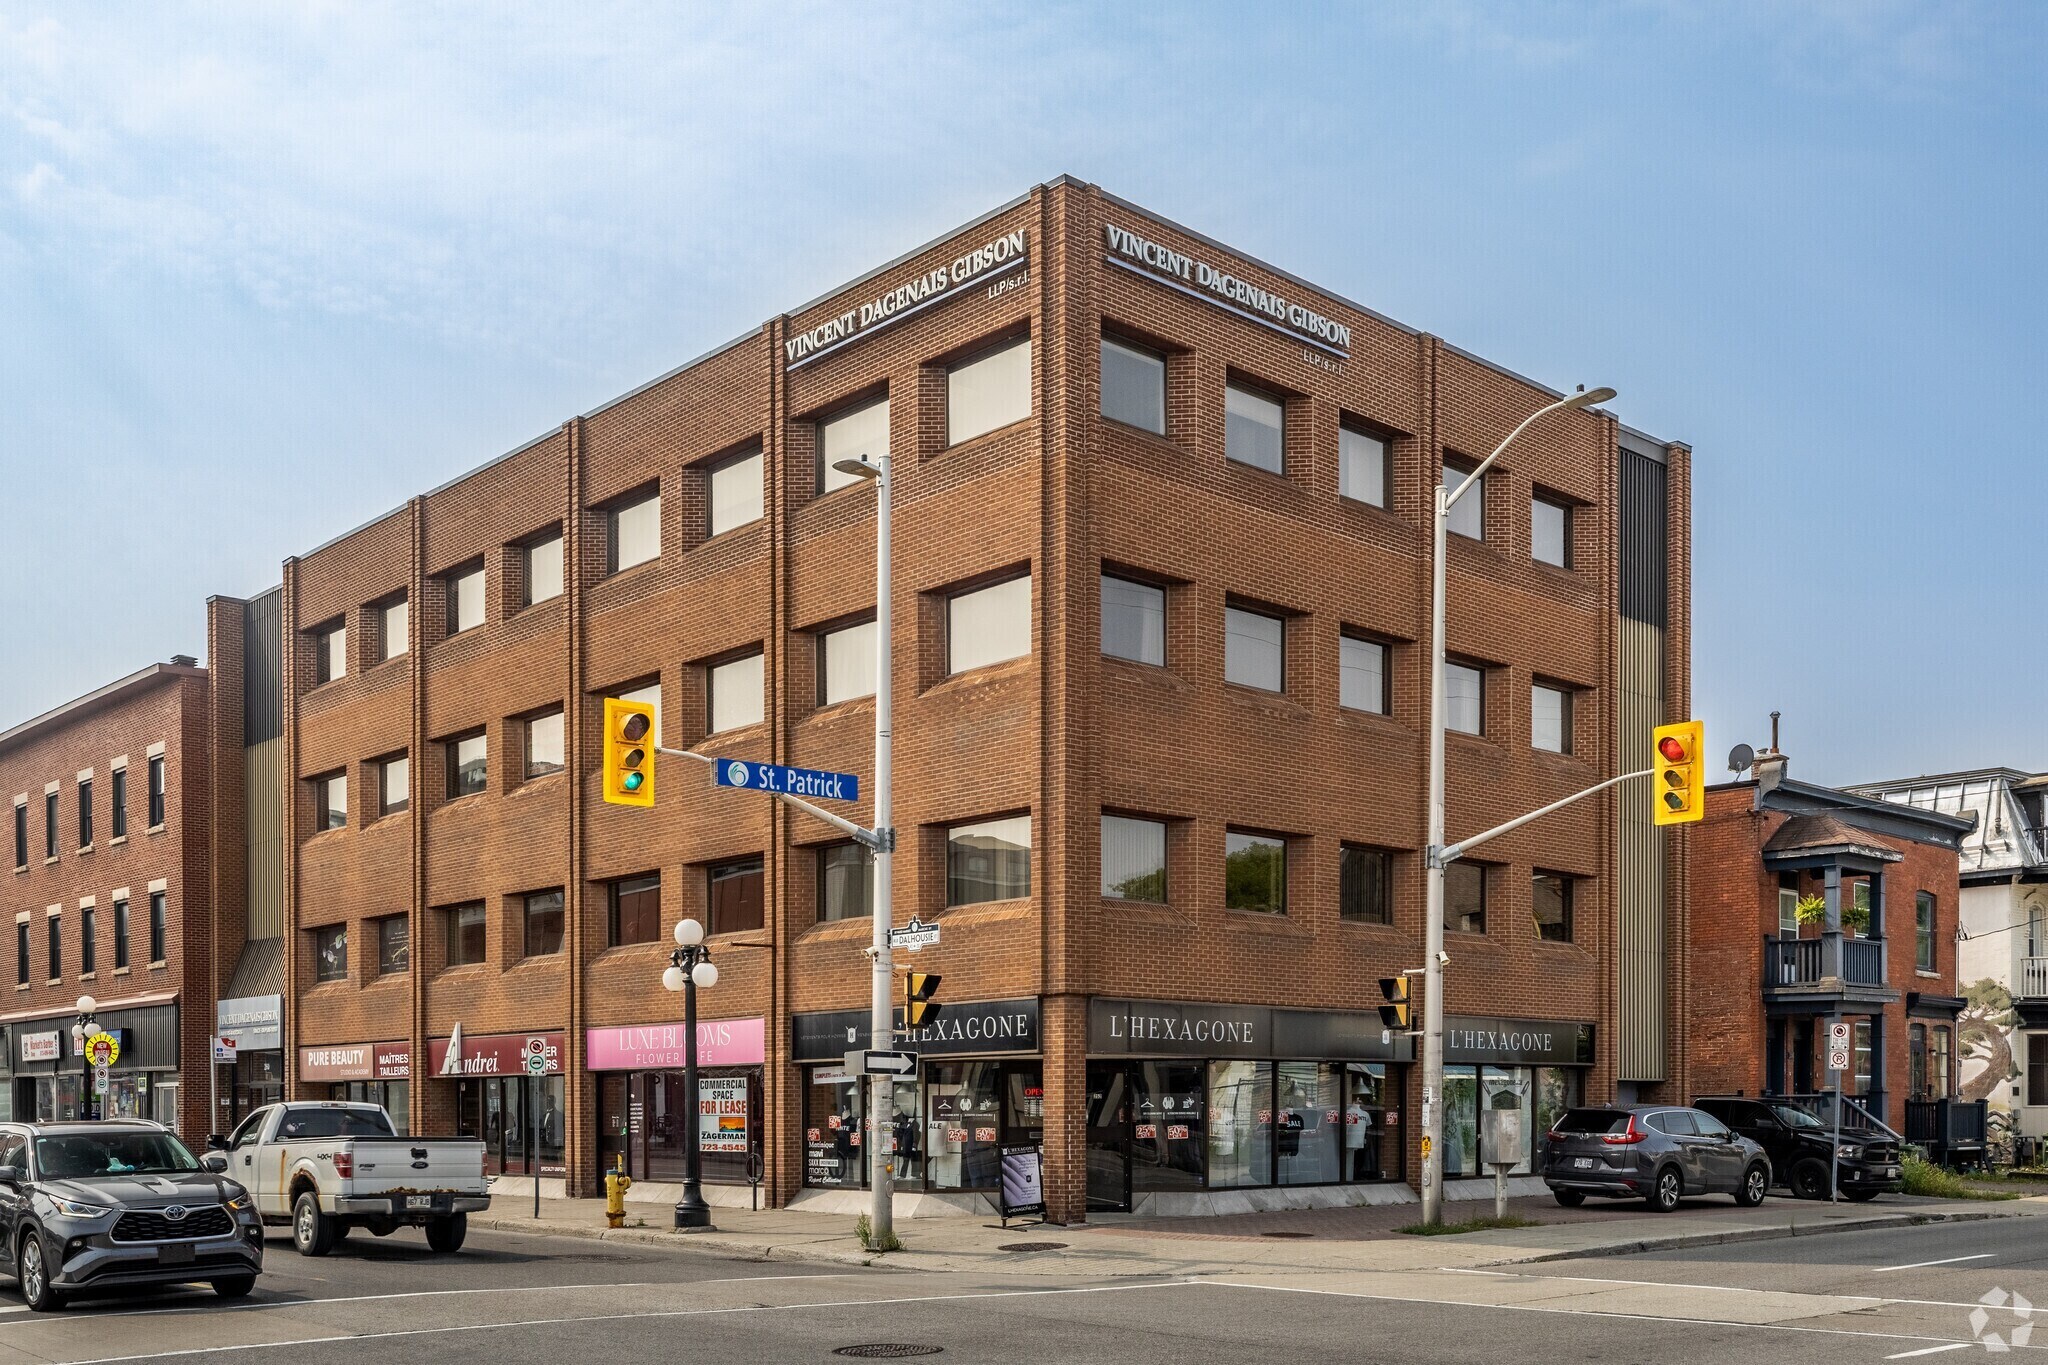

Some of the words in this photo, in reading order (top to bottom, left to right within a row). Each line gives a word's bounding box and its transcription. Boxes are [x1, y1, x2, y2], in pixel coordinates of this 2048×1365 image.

[987, 269, 1031, 300] LLP/s.r.l.
[1106, 223, 1193, 279] VINCENT
[1196, 262, 1286, 321] DAGENAIS
[1287, 304, 1351, 348] GIBSON
[785, 310, 856, 360] VINCENT
[860, 266, 948, 326] DAGENAIS
[950, 228, 1026, 283] GIBSON
[759, 765, 780, 791] St.
[787, 769, 843, 799] Patrick
[899, 932, 934, 944] DALHOUSIE
[891, 1014, 1028, 1043] 'EXAGONE
[1110, 1015, 1254, 1043] L'HEXAGONE
[620, 1028, 660, 1051] LUXE
[663, 1023, 731, 1049] BLOMS
[1450, 1029, 1552, 1052] L'HEXAGONE
[308, 1051, 330, 1066] PURE
[331, 1050, 364, 1066] BEAUTY
[521, 1046, 557, 1058] MER
[636, 1052, 680, 1064] FLOWER
[379, 1052, 409, 1065] MAÎTRES
[379, 1066, 409, 1077] TAILLEURS
[700, 1079, 746, 1090] COMMERCIAL
[712, 1090, 734, 1100] SPACE
[700, 1100, 717, 1114] FOR
[719, 1100, 747, 1114] LEASE
[928, 1122, 942, 1130] ALE
[1137, 1126, 1156, 1135] 25%
[1168, 1126, 1188, 1136] 50%
[701, 1132, 745, 1140] ZAGERMAN
[948, 1129, 968, 1139] 25%
[976, 1128, 996, 1138] 50%
[701, 1143, 746, 1151] 723-4545
[808, 1149, 824, 1157] mavi
